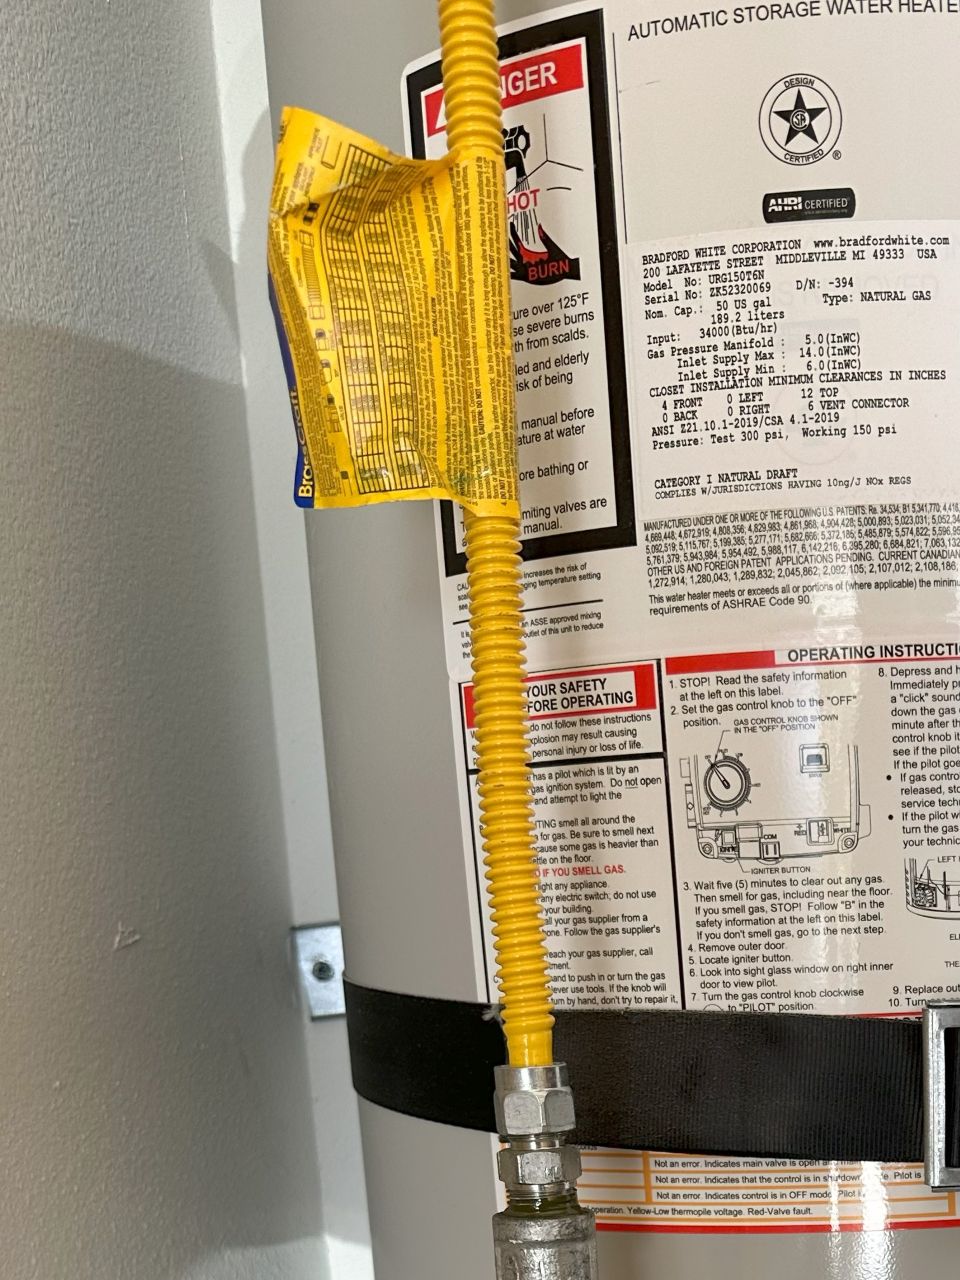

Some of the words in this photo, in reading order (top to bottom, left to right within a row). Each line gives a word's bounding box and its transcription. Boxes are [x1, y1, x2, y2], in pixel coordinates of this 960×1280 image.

[628, 10, 728, 40] AUTOMATIC
[733, 0, 821, 24] STORAGE
[826, 0, 893, 15] WATER
[500, 62, 557, 99] GER
[784, 77, 815, 88] DESIGN
[784, 148, 825, 163] CERTIFIED
[507, 189, 540, 212] HOT
[768, 197, 802, 212] AHRI
[804, 198, 848, 209] CERTIFIED
[642, 250, 690, 266] BRADFORD
[694, 245, 726, 258] WHITE
[731, 239, 802, 254] CORPORATION
[813, 235, 950, 248] www.bradfordwhite.com
[528, 259, 569, 280] BURN
[643, 266, 660, 279] 200
[666, 260, 721, 276] LAFAYETTE
[726, 256, 764, 269] STREET
[775, 250, 847, 264] MIDDLEVILLE
[852, 250, 866, 260] MI
[872, 248, 904, 260] 49333
[916, 248, 938, 259] USA
[643, 278, 673, 292] Model
[684, 276, 702, 288] No:
[708, 269, 765, 284] URG150T6N
[644, 291, 680, 305] Serial
[684, 290, 702, 300] No:
[709, 282, 771, 297] ZK52320069
[796, 278, 820, 291] D/N:
[828, 276, 854, 288] -394
[531, 302, 554, 316] over
[558, 293, 589, 316] 125°F
[644, 310, 667, 320] Nom.
[674, 306, 702, 318] Cap.:
[716, 300, 728, 312] 50
[734, 298, 747, 310] US
[752, 296, 772, 310] gal
[822, 293, 853, 306] Type:
[860, 290, 906, 302] NATURAL
[912, 290, 932, 301] GAS
[526, 318, 561, 333] severe
[563, 311, 595, 326] burns
[711, 311, 741, 325] 189.2
[748, 310, 785, 321] liters
[646, 333, 680, 345] Input:
[699, 322, 777, 338] 34000(Btu/hr)
[649, 384, 684, 398] CLOSET
[690, 377, 763, 393] INSTALLATION
[768, 374, 814, 386] MINIMUM
[818, 371, 883, 383] CLEARANCES
[889, 370, 902, 381] IN
[908, 370, 946, 380] INCHES
[651, 424, 674, 437] ANSI
[680, 415, 784, 433] Z21.10.1-2019/CSA
[789, 412, 840, 424] 4.1-2019
[652, 438, 703, 450] Pressure:
[710, 433, 736, 444] Test
[741, 430, 759, 442] 300
[764, 429, 788, 443] psi,
[801, 426, 847, 438] Working
[853, 424, 872, 435] 150
[878, 424, 897, 437] psi
[788, 647, 875, 662] OPERATING
[559, 678, 607, 694] SAFETY
[679, 676, 710, 688] STOP!
[715, 674, 742, 686] Read
[743, 674, 759, 684] the
[761, 672, 790, 684] safety
[792, 670, 847, 681] information
[542, 868, 550, 878] IF
[551, 867, 570, 877] YOU
[572, 866, 602, 876] SMELL
[604, 864, 626, 874] GAS.
[657, 1190, 670, 1200] Not
[671, 1192, 680, 1200] an
[682, 1191, 701, 1200] error.
[747, 1207, 791, 1216] Red-Valve
[792, 1207, 813, 1215] fault.
